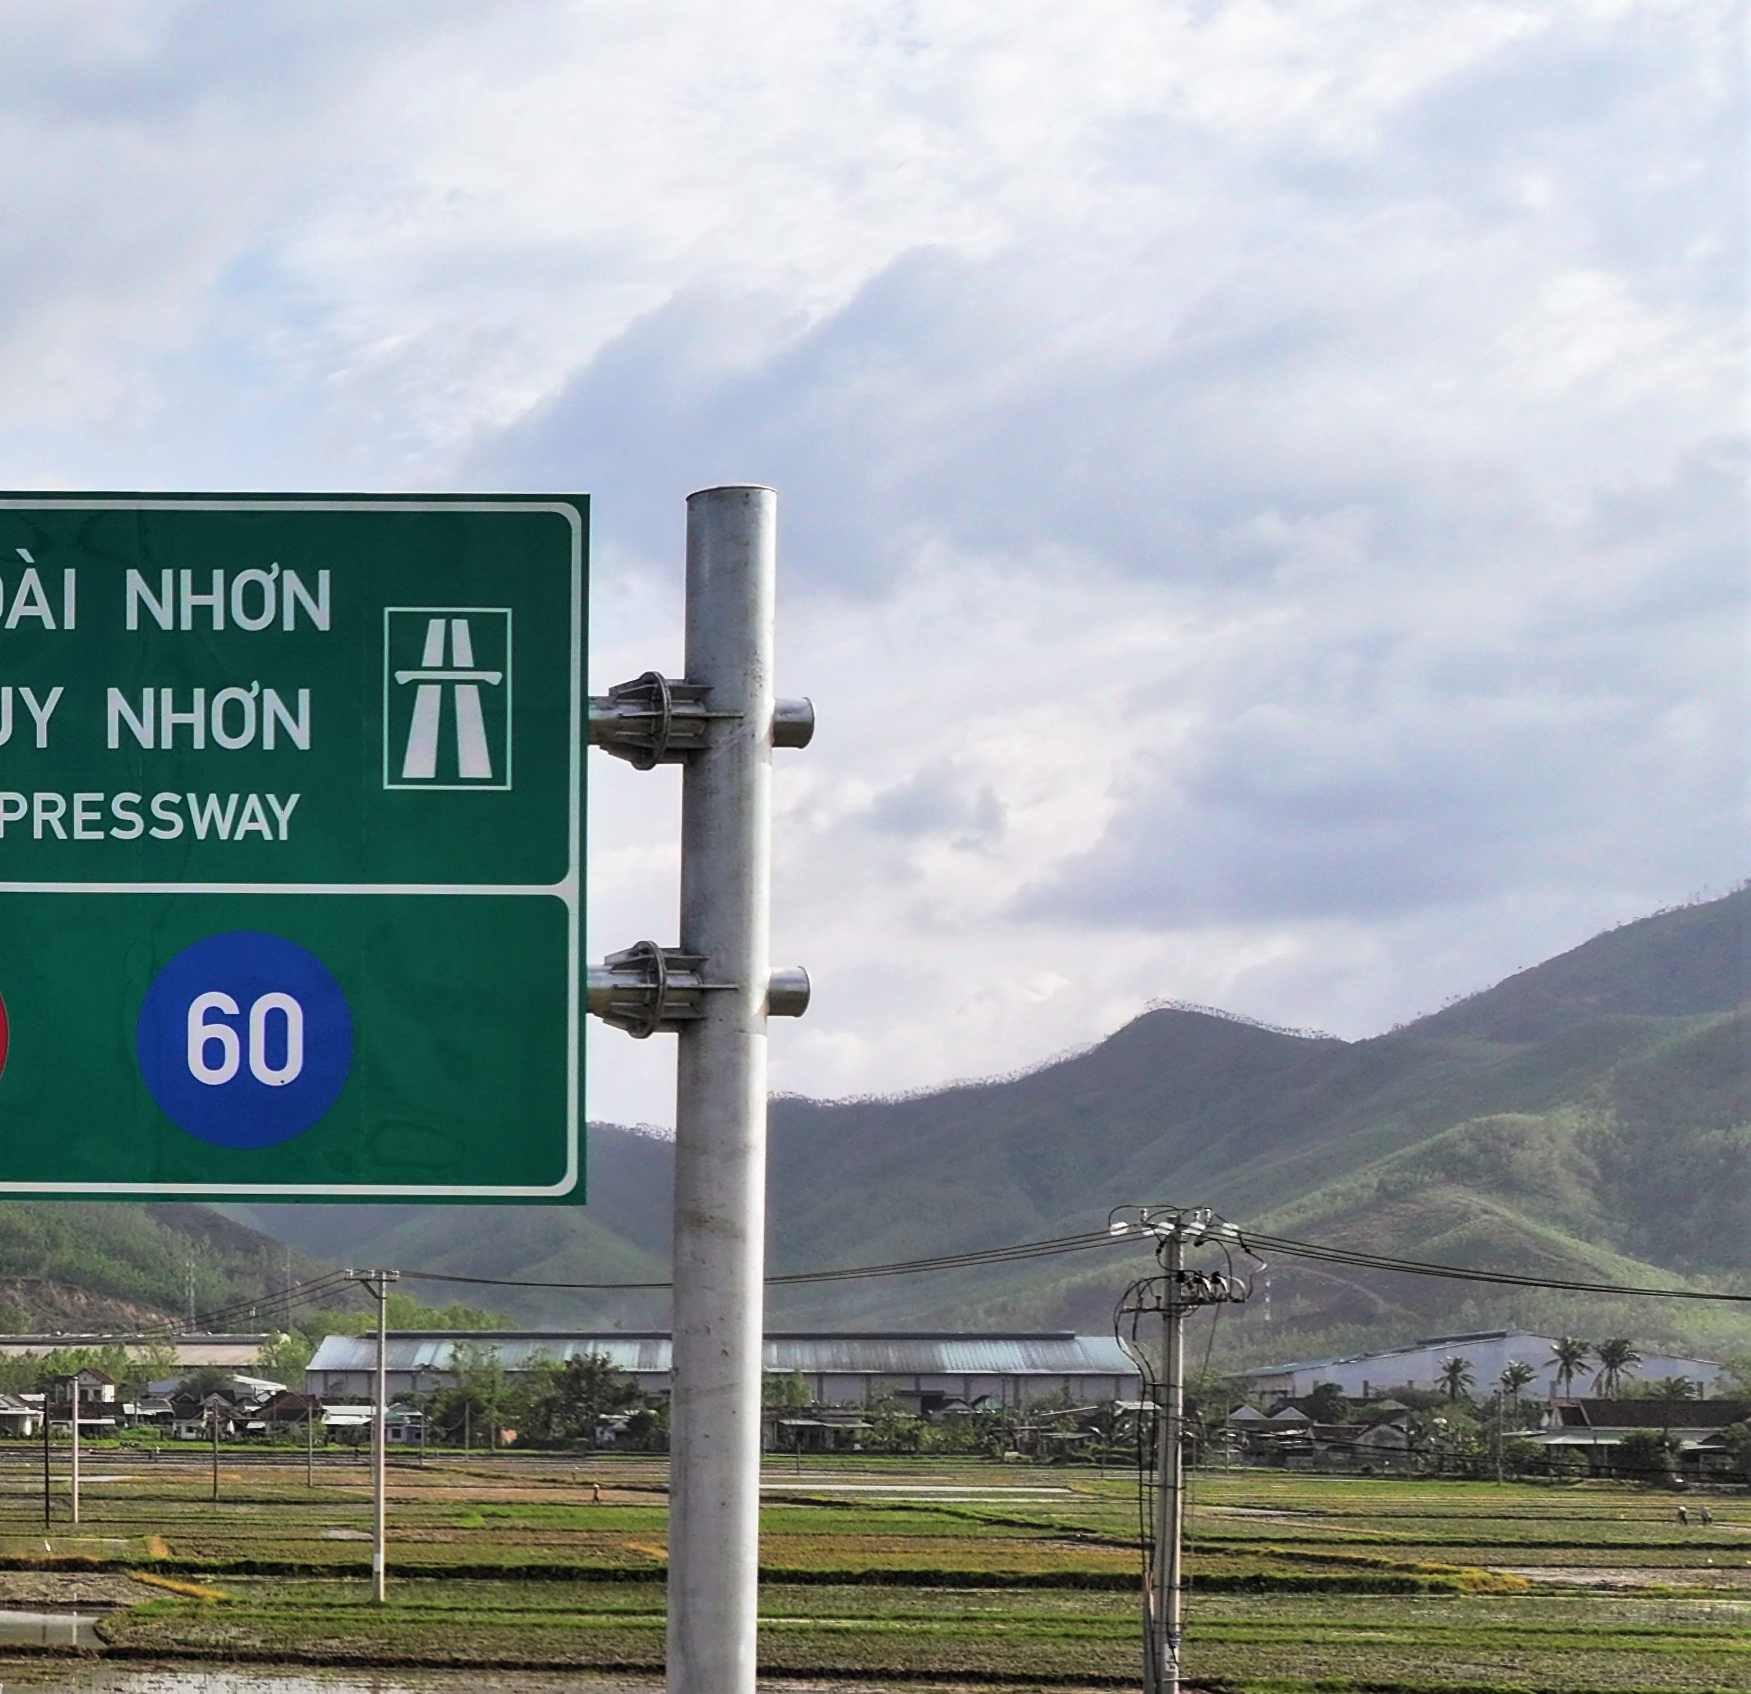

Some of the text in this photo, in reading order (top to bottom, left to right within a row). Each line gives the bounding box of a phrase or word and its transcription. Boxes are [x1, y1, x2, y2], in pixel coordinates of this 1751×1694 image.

[126, 562, 330, 631] NHƠN
[107, 680, 310, 750] NHƠN
[187, 991, 304, 1087] 60
